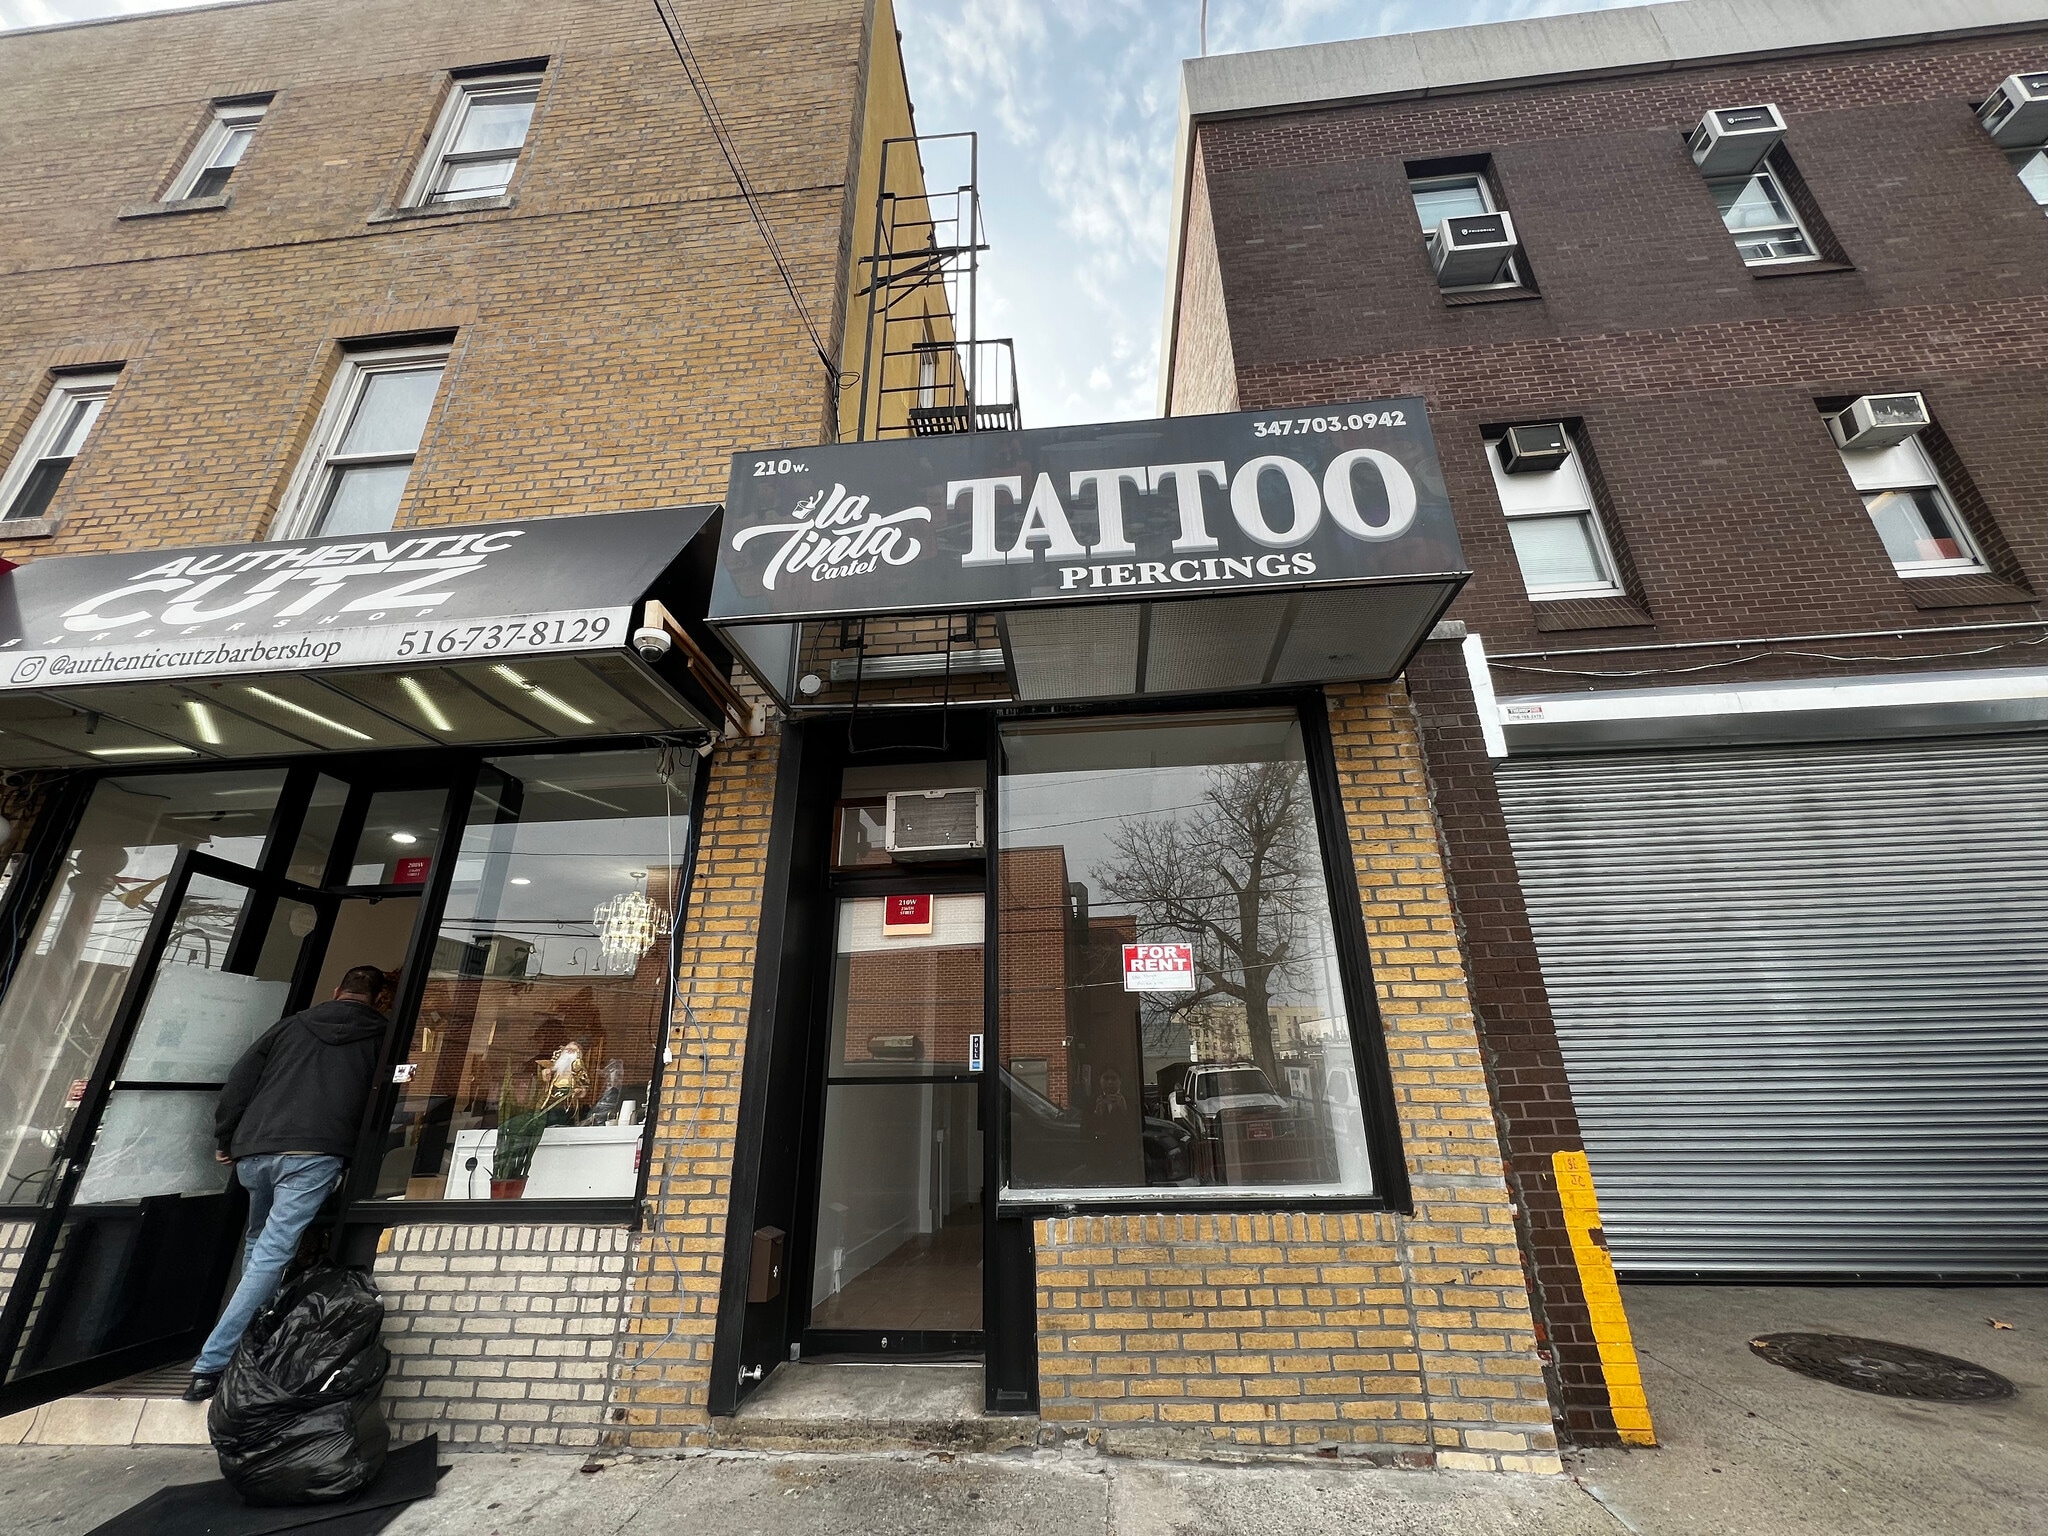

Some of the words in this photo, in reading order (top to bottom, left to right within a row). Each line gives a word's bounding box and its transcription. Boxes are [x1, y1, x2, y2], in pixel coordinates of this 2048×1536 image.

[1253, 410, 1407, 438] 347.703.0942
[946, 448, 1418, 568] TATTOO
[128, 530, 526, 580] AUTHENTIC
[732, 506, 932, 591] Tinta
[811, 555, 879, 583] Cartel
[1058, 551, 1317, 590] PIERCINGS
[59, 554, 487, 632] CUTZ
[49, 636, 342, 675] @authenticcutzbarbershop
[397, 616, 611, 656] 516-737-8129
[1130, 958, 1187, 971] RENT
[1136, 946, 1179, 959] FOR
